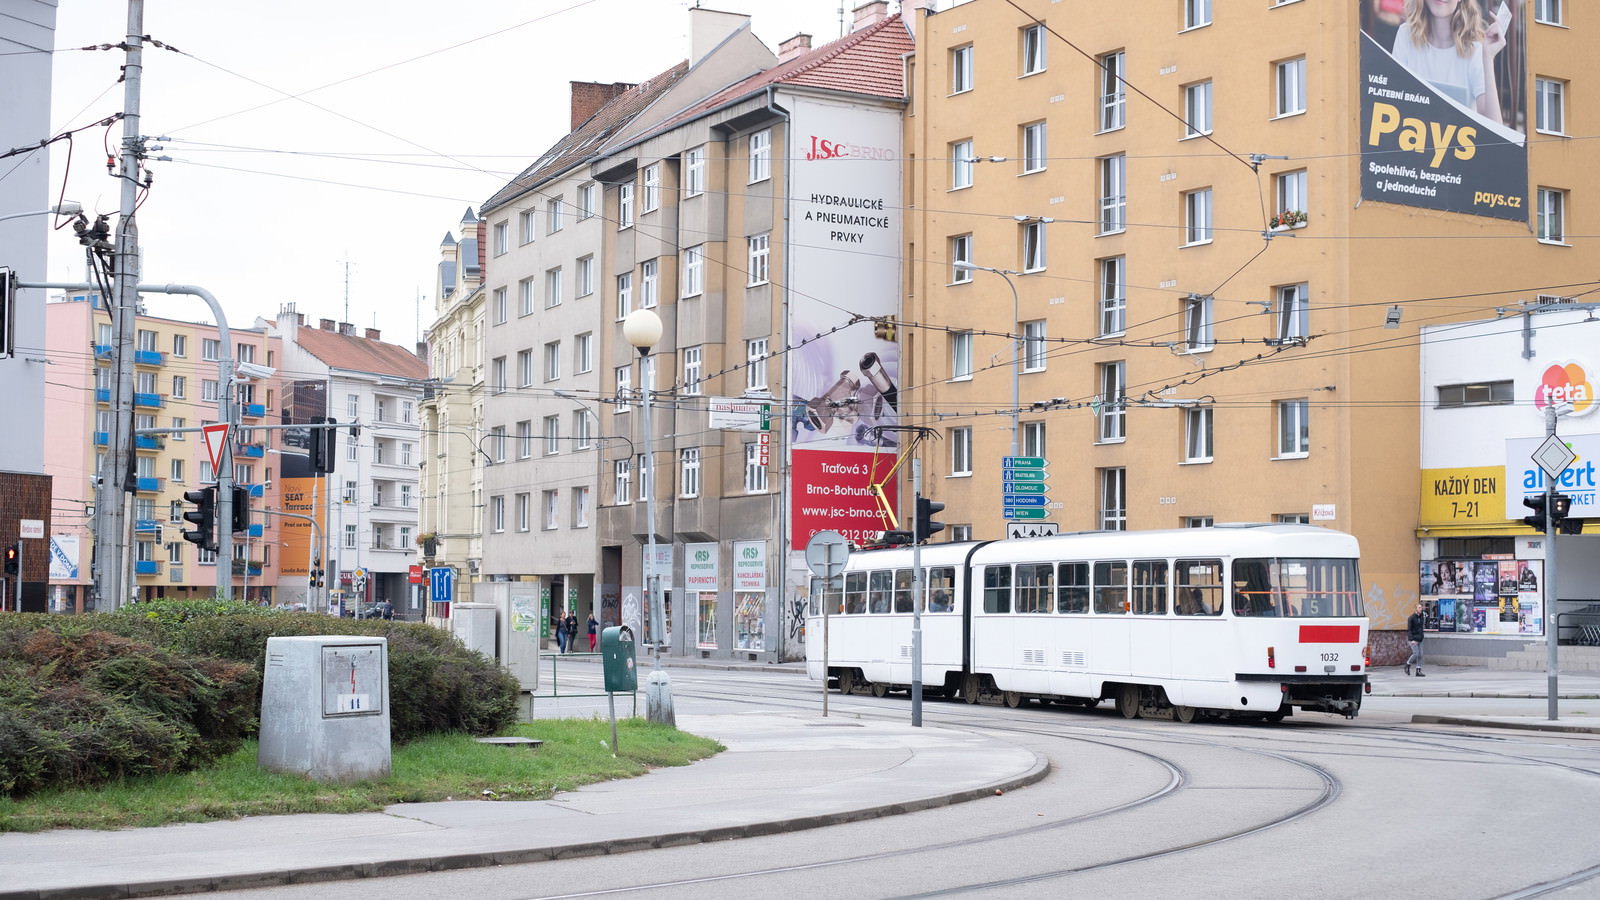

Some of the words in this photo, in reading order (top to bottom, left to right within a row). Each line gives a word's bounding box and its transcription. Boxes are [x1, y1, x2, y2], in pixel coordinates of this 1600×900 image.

[1368, 74, 1388, 85] VAŠE
[1368, 86, 1403, 100] PLATEBNÍ
[1404, 91, 1430, 105] BRÁNA
[1368, 102, 1477, 168] Pays
[1369, 161, 1418, 180] Spolehlivá,
[1420, 169, 1462, 185] bezpečná
[1376, 181, 1383, 189] a
[1383, 179, 1437, 197] jednoduchá
[811, 193, 883, 210] HYDRAULICKÉ
[1473, 191, 1521, 208] pays.cz
[805, 211, 813, 221] A
[816, 211, 889, 229] PNEUMATICKÉ
[830, 231, 864, 244] PRVKY
[1542, 383, 1588, 404] teta
[821, 462, 859, 475] Traťová
[862, 464, 869, 475] 3
[1523, 461, 1596, 489] alert
[806, 483, 881, 497] Brno-Bohunic
[1434, 474, 1469, 496] KAŽDÝ
[1473, 477, 1496, 494] DEN
[284, 493, 304, 501] SEAT
[802, 507, 887, 519] www.jsc-brno.cz
[842, 529, 860, 541] 212
[1310, 600, 1319, 614] 5
[1320, 653, 1339, 662] 1032
